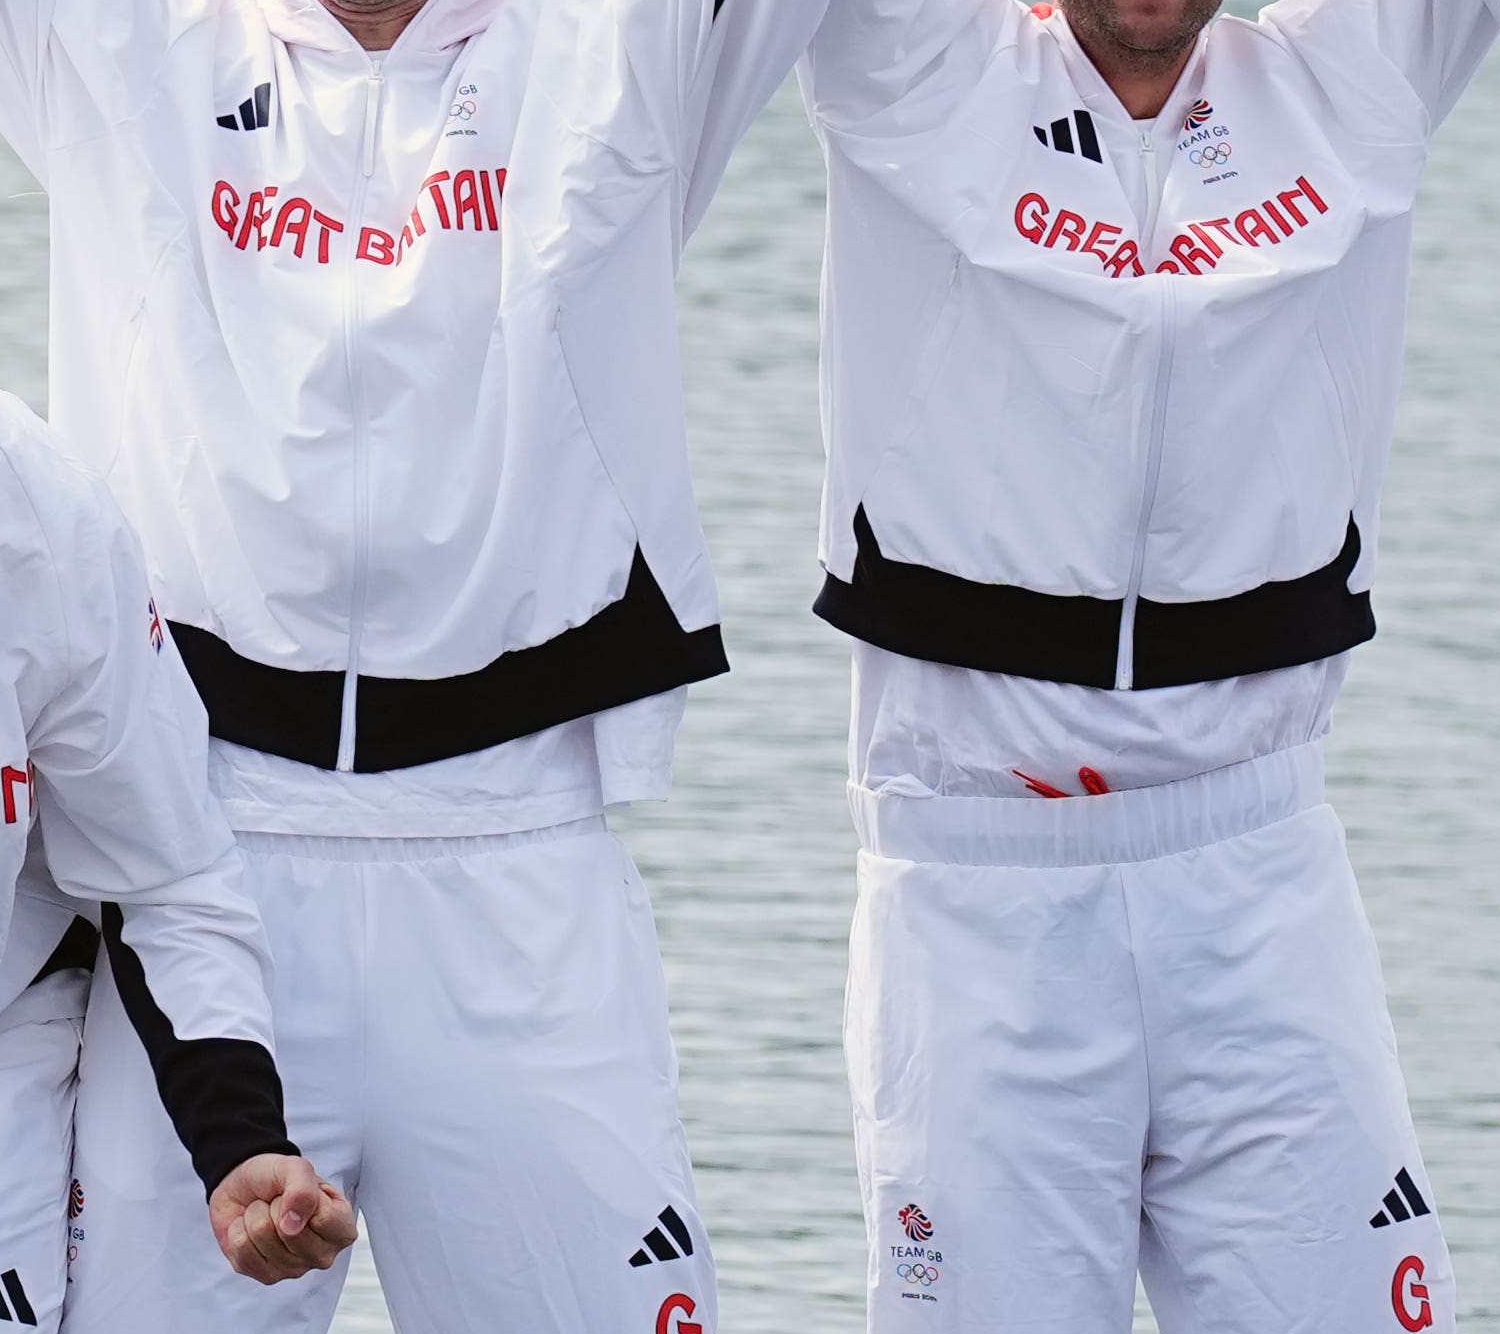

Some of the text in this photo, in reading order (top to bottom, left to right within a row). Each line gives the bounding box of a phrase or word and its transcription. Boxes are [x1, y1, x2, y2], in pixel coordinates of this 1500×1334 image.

[459, 84, 478, 96] GB
[1177, 125, 1229, 151] TEAM GB
[72, 1228, 85, 1240] GB
[891, 1246, 943, 1263] TEAM GB
